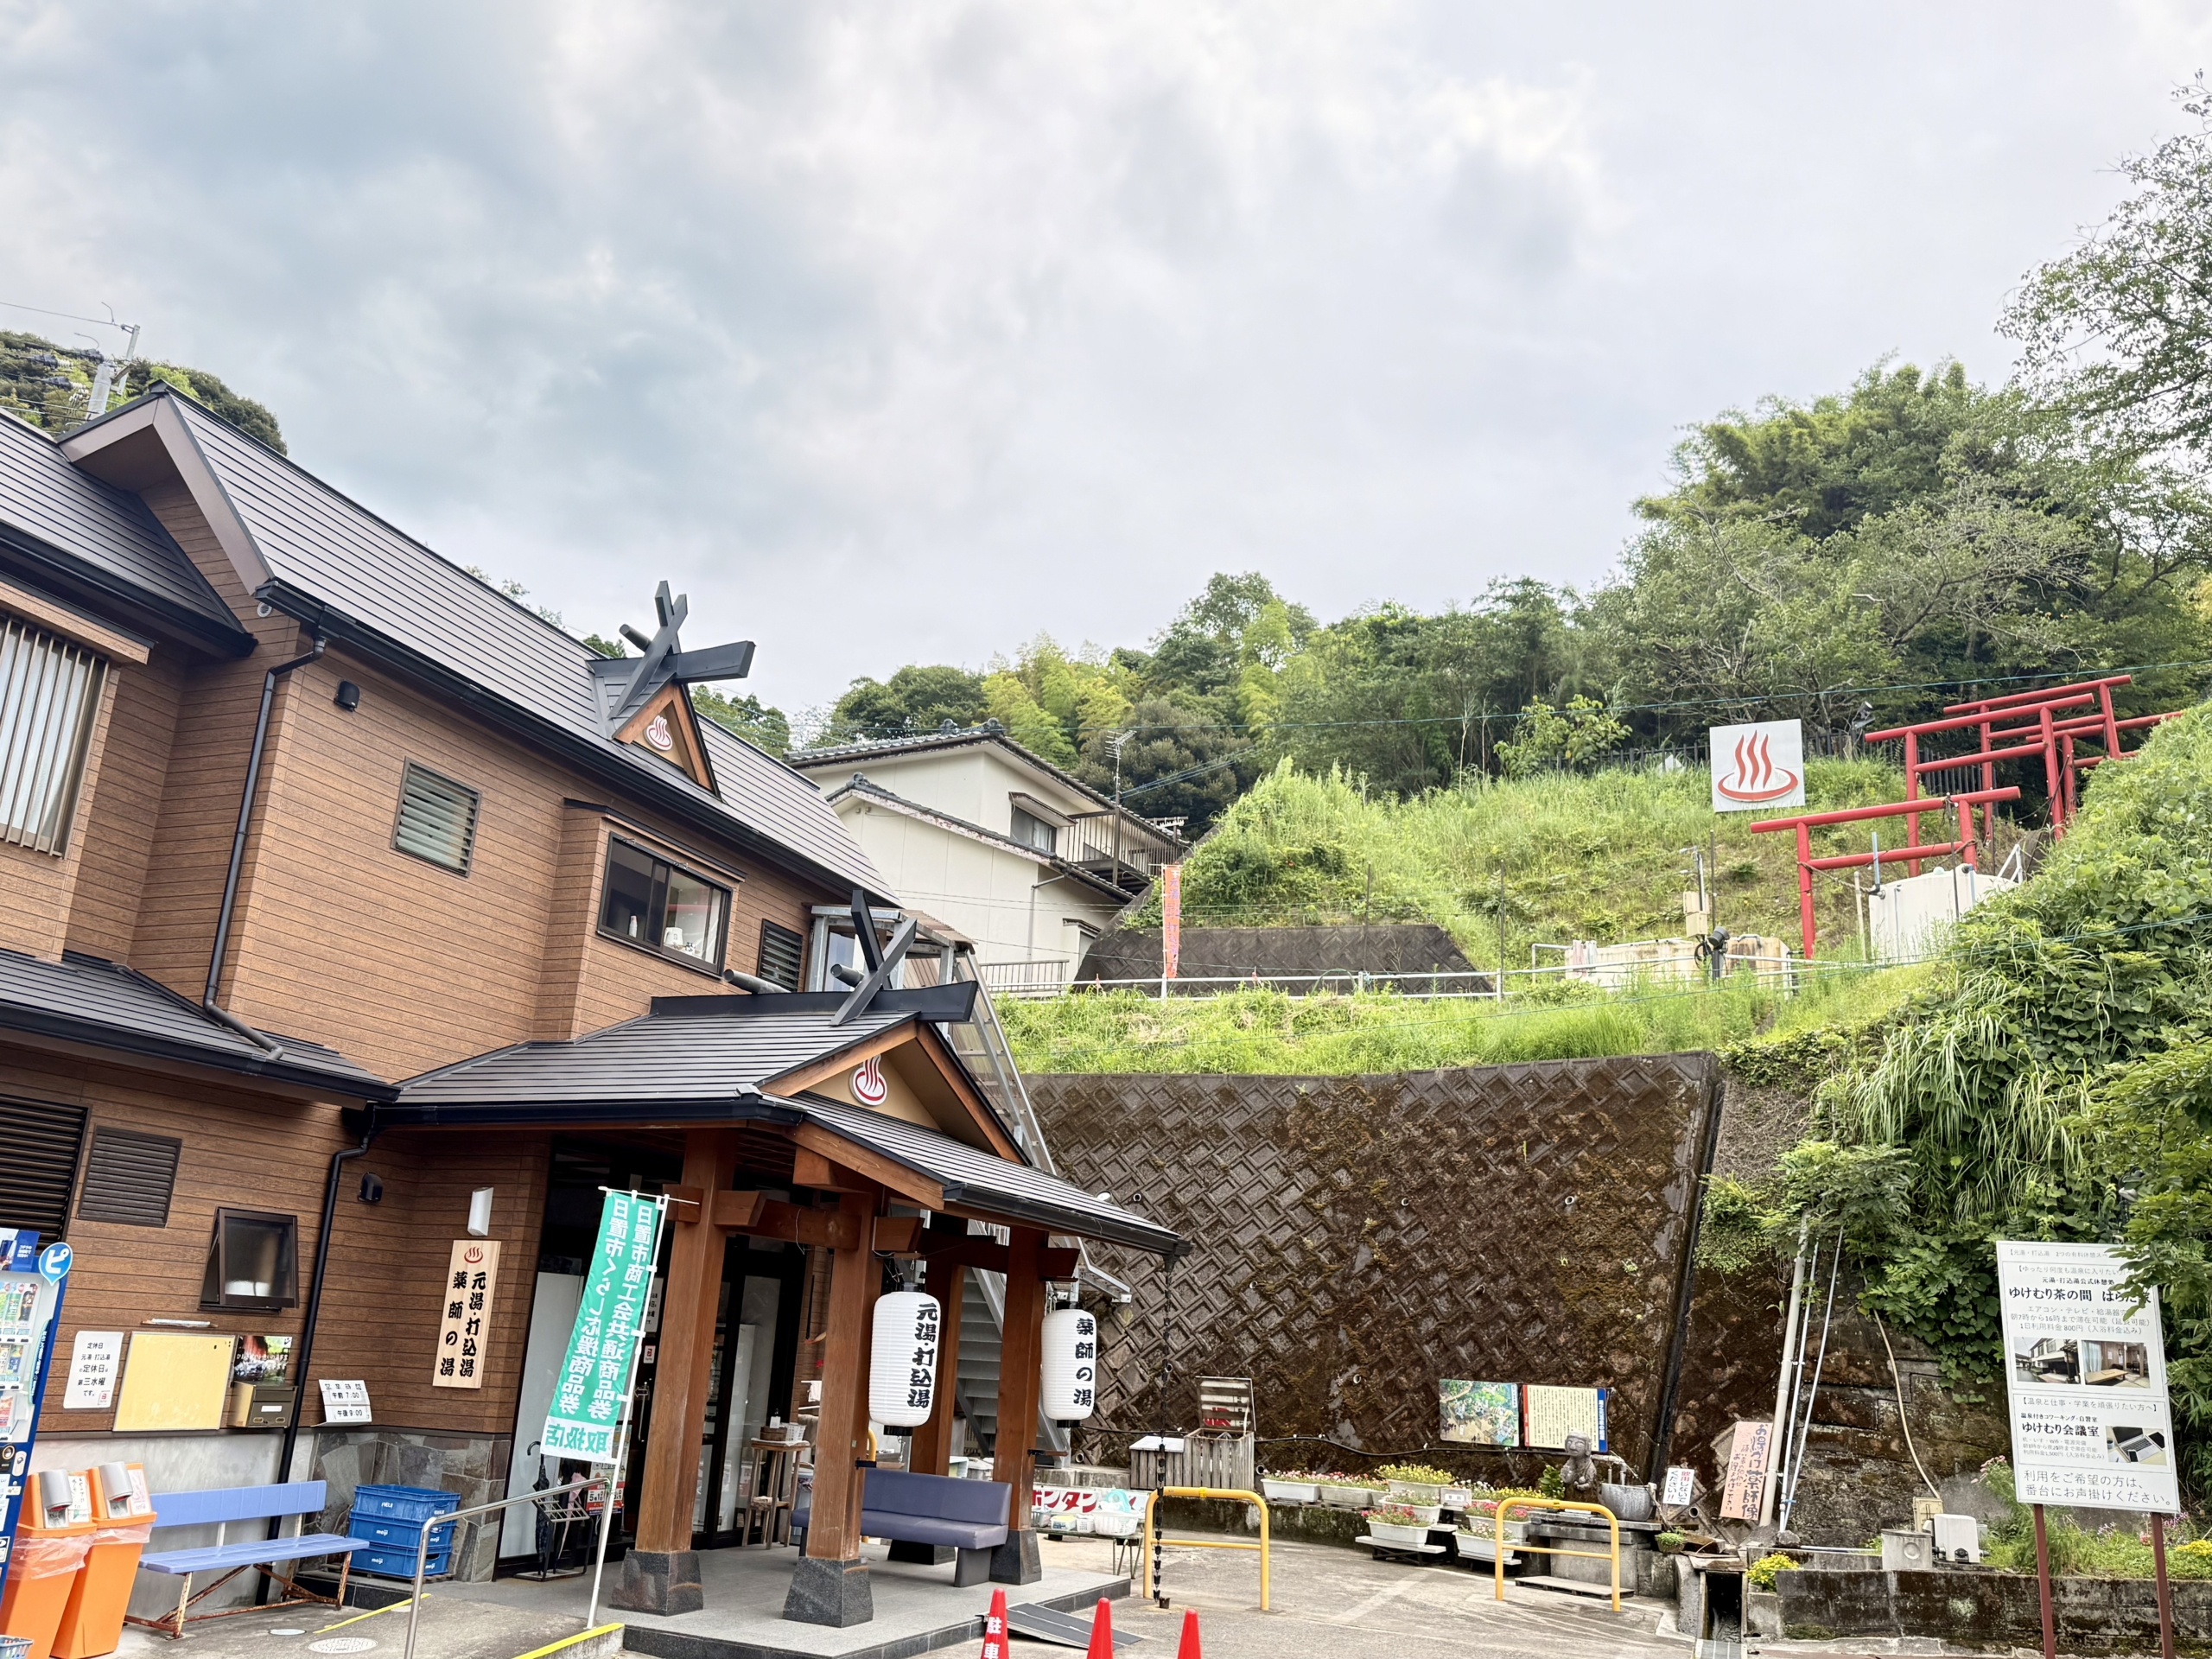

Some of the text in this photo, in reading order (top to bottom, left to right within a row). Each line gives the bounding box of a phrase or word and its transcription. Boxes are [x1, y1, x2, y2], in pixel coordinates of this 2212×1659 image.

[2009, 1287, 2092, 1302] ゆけむり茶の間
[440, 1270, 468, 1377] 薬師の湯
[459, 1271, 486, 1378] 元湯・打込湯
[2027, 1306, 2136, 1318] エアコン・テレビ・給湯器完
[906, 1302, 938, 1409] 元湯・打込湯
[1072, 1318, 1094, 1407] 薬師の湯
[2022, 1422, 2100, 1438] ゆけむり会議室
[1678, 1471, 1691, 1503] 飲用しないで
[2024, 1470, 2143, 1490] 利用をご希望の方は、
[2025, 1484, 2171, 1506] 番台にお声掛けください。
[983, 1616, 1002, 1659] 駐車
